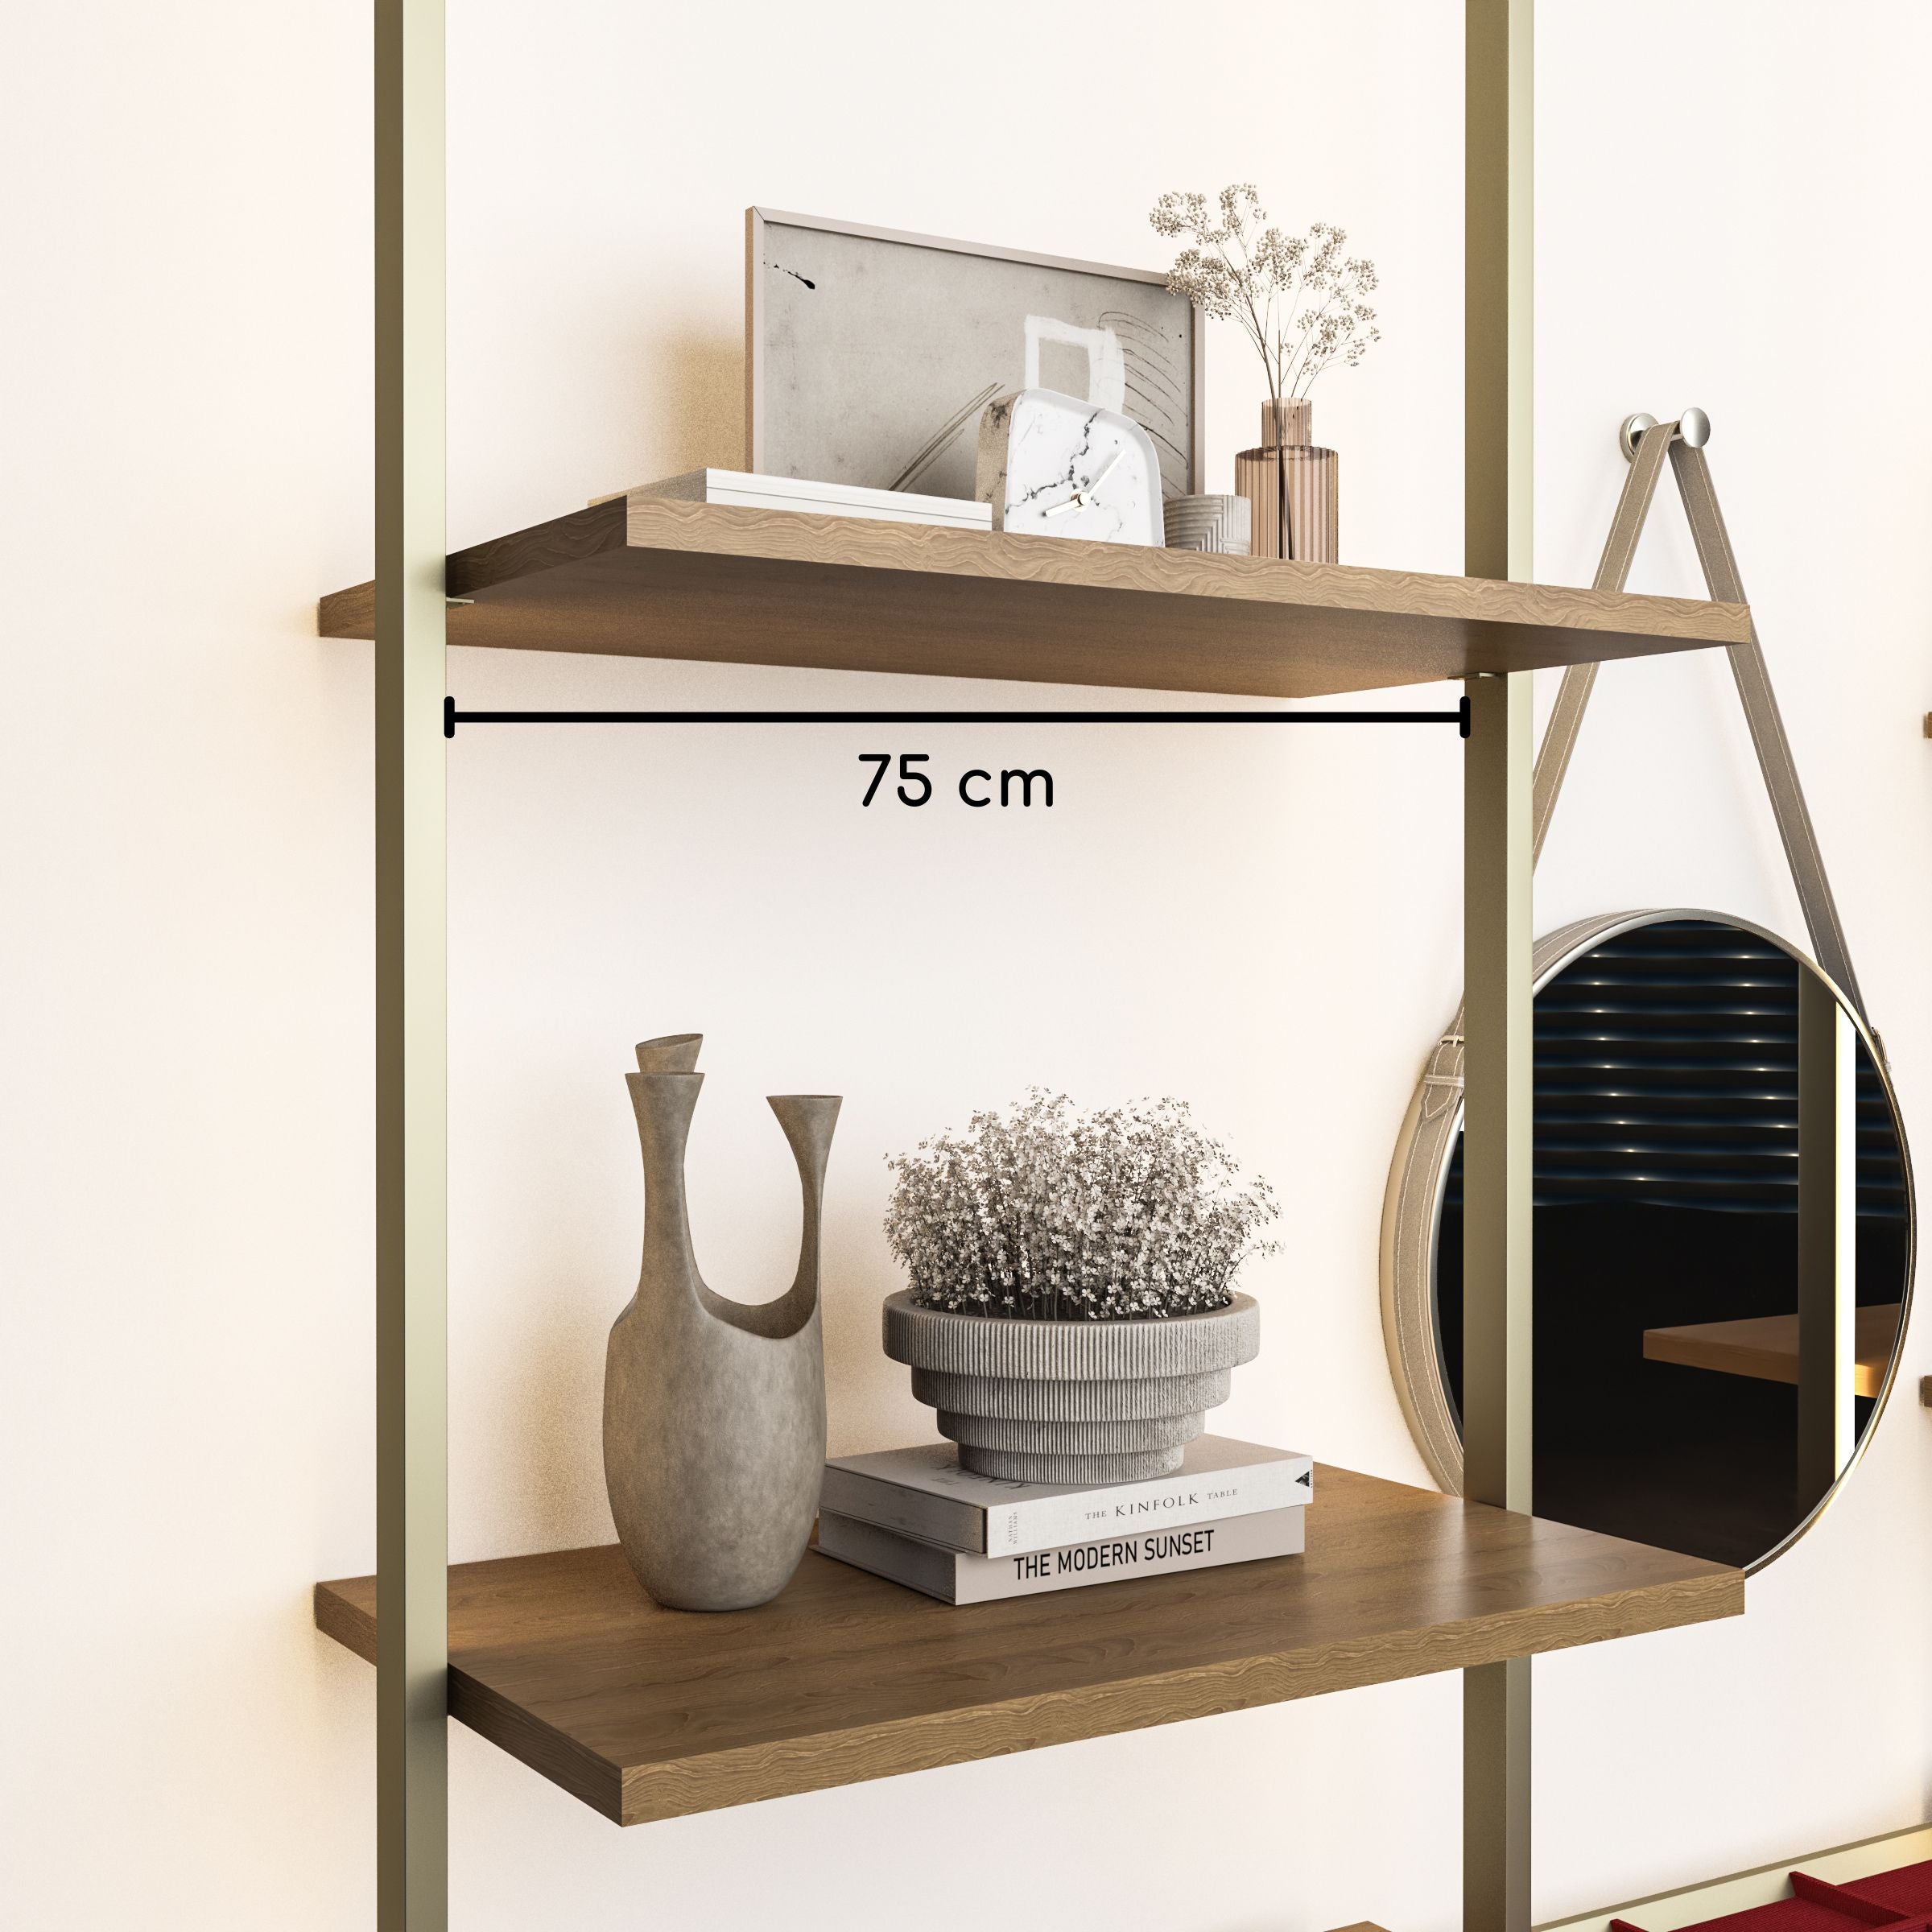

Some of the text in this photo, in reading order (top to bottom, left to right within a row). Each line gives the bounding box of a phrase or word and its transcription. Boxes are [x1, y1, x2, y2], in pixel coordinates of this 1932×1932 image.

[1085, 1488, 1238, 1520] THE KINFOLK TABLE
[1013, 1530, 1215, 1580] THE MODERN SUNSET
